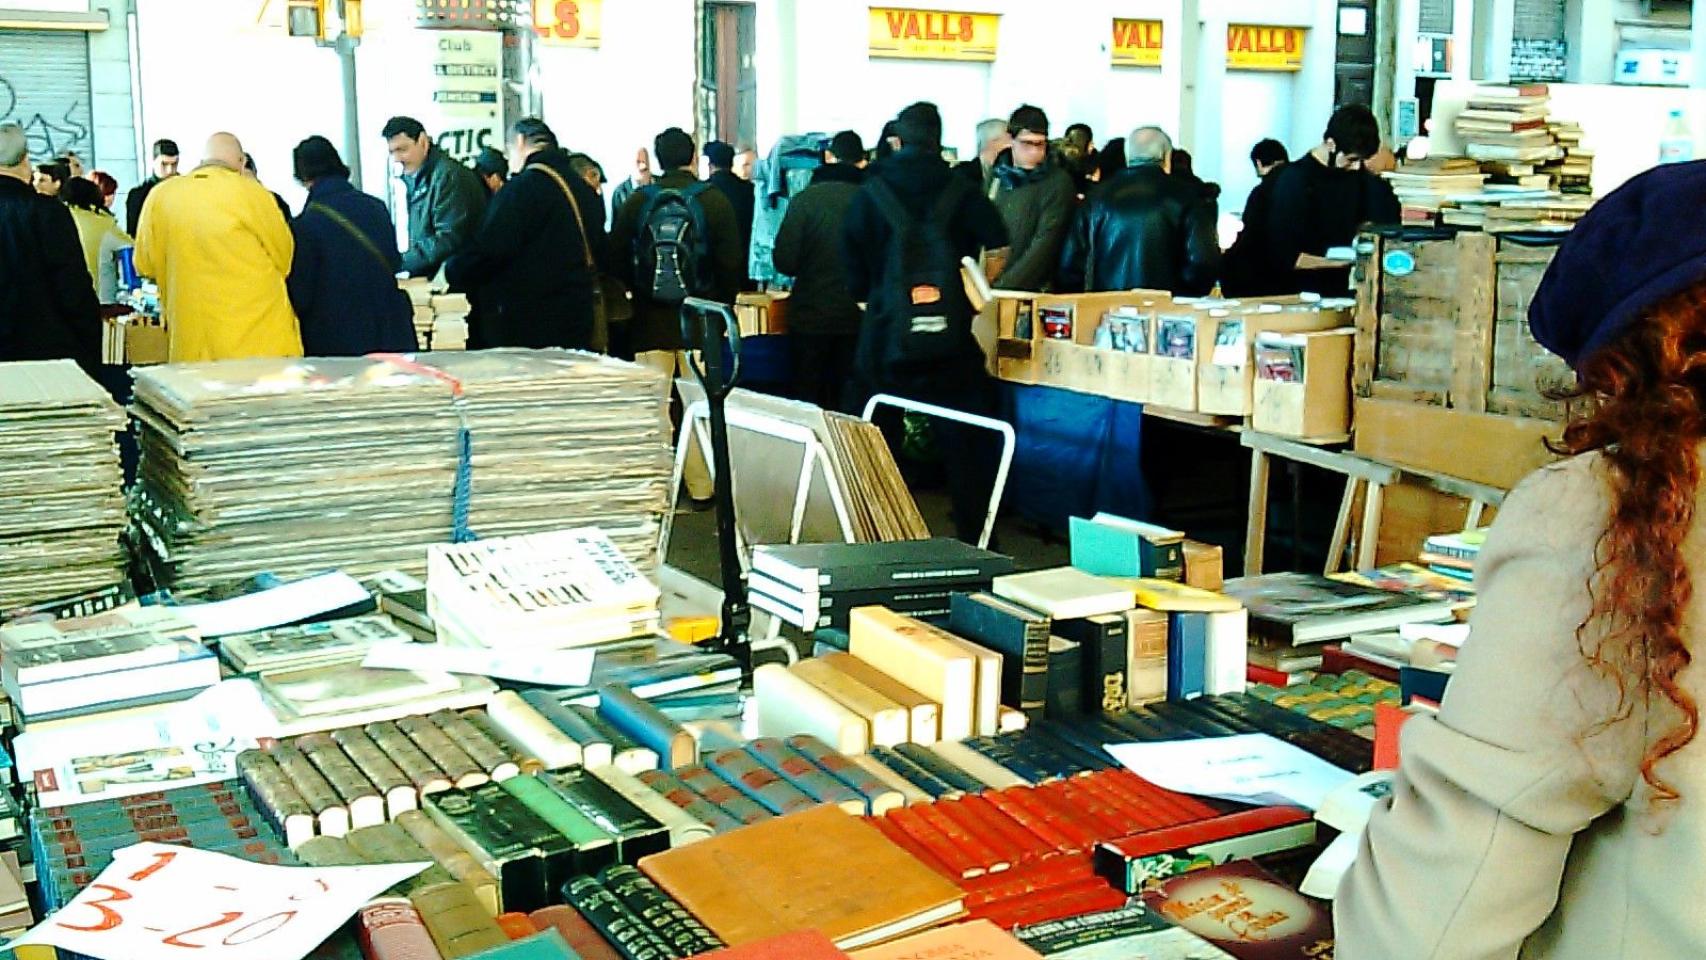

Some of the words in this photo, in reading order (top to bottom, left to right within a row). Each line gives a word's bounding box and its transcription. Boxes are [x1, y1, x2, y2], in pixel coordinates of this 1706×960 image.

[886, 11, 974, 42] VALLS
[438, 39, 472, 51] Club
[56, 883, 133, 932] 3
